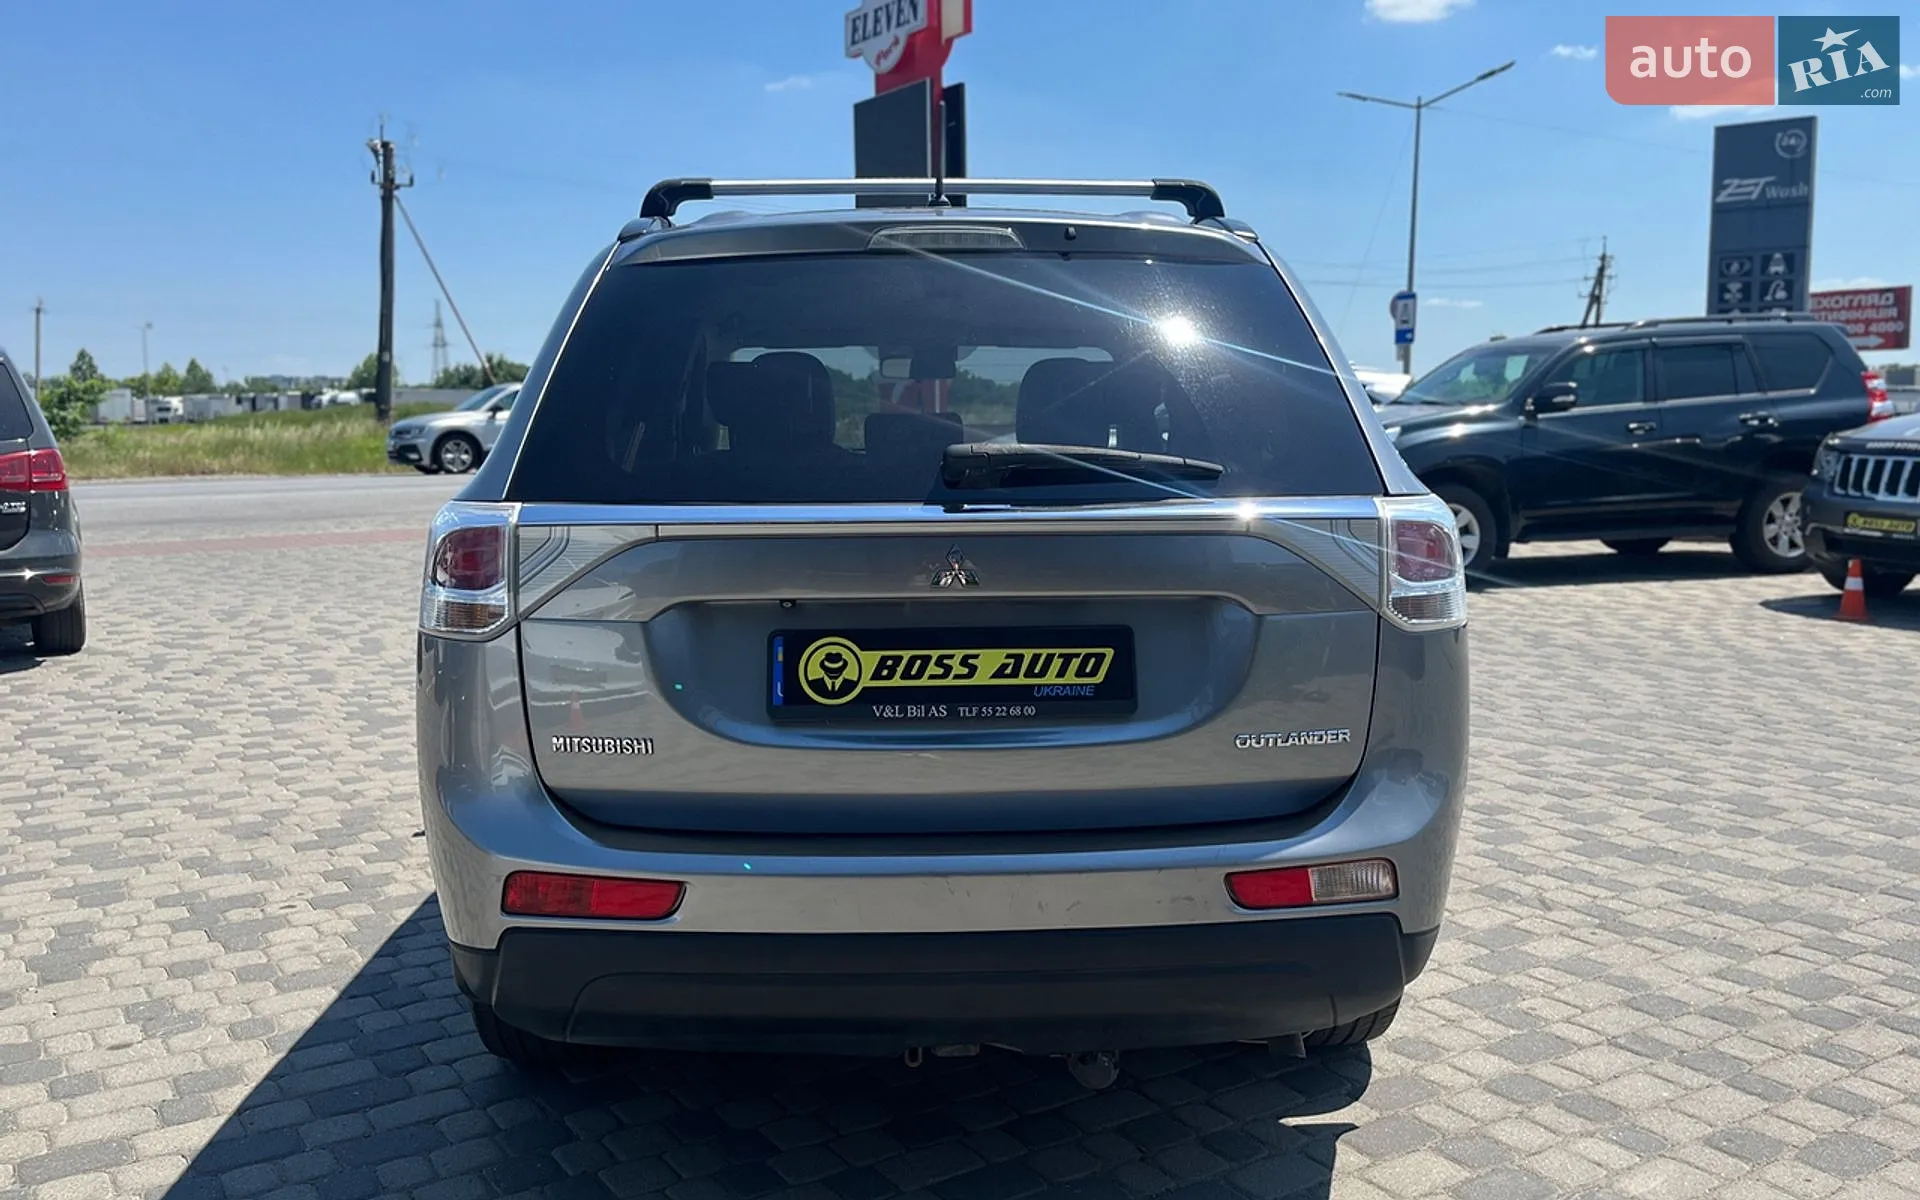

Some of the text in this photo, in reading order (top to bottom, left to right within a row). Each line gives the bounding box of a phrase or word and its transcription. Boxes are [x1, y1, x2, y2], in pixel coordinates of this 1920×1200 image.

[851, 0, 918, 46] ELEVEN
[869, 652, 1109, 681] BOSS AUTO
[1033, 685, 1095, 697] UKRAINE
[872, 705, 904, 718] V&L
[907, 705, 925, 717] Bil
[928, 705, 948, 717] AS
[957, 706, 979, 717] TLF
[981, 706, 993, 717] 55
[995, 706, 1008, 717] 22
[1009, 705, 1022, 716] 68
[551, 736, 654, 755] MITSUBISHI
[1235, 729, 1351, 749] OUTLANDER
